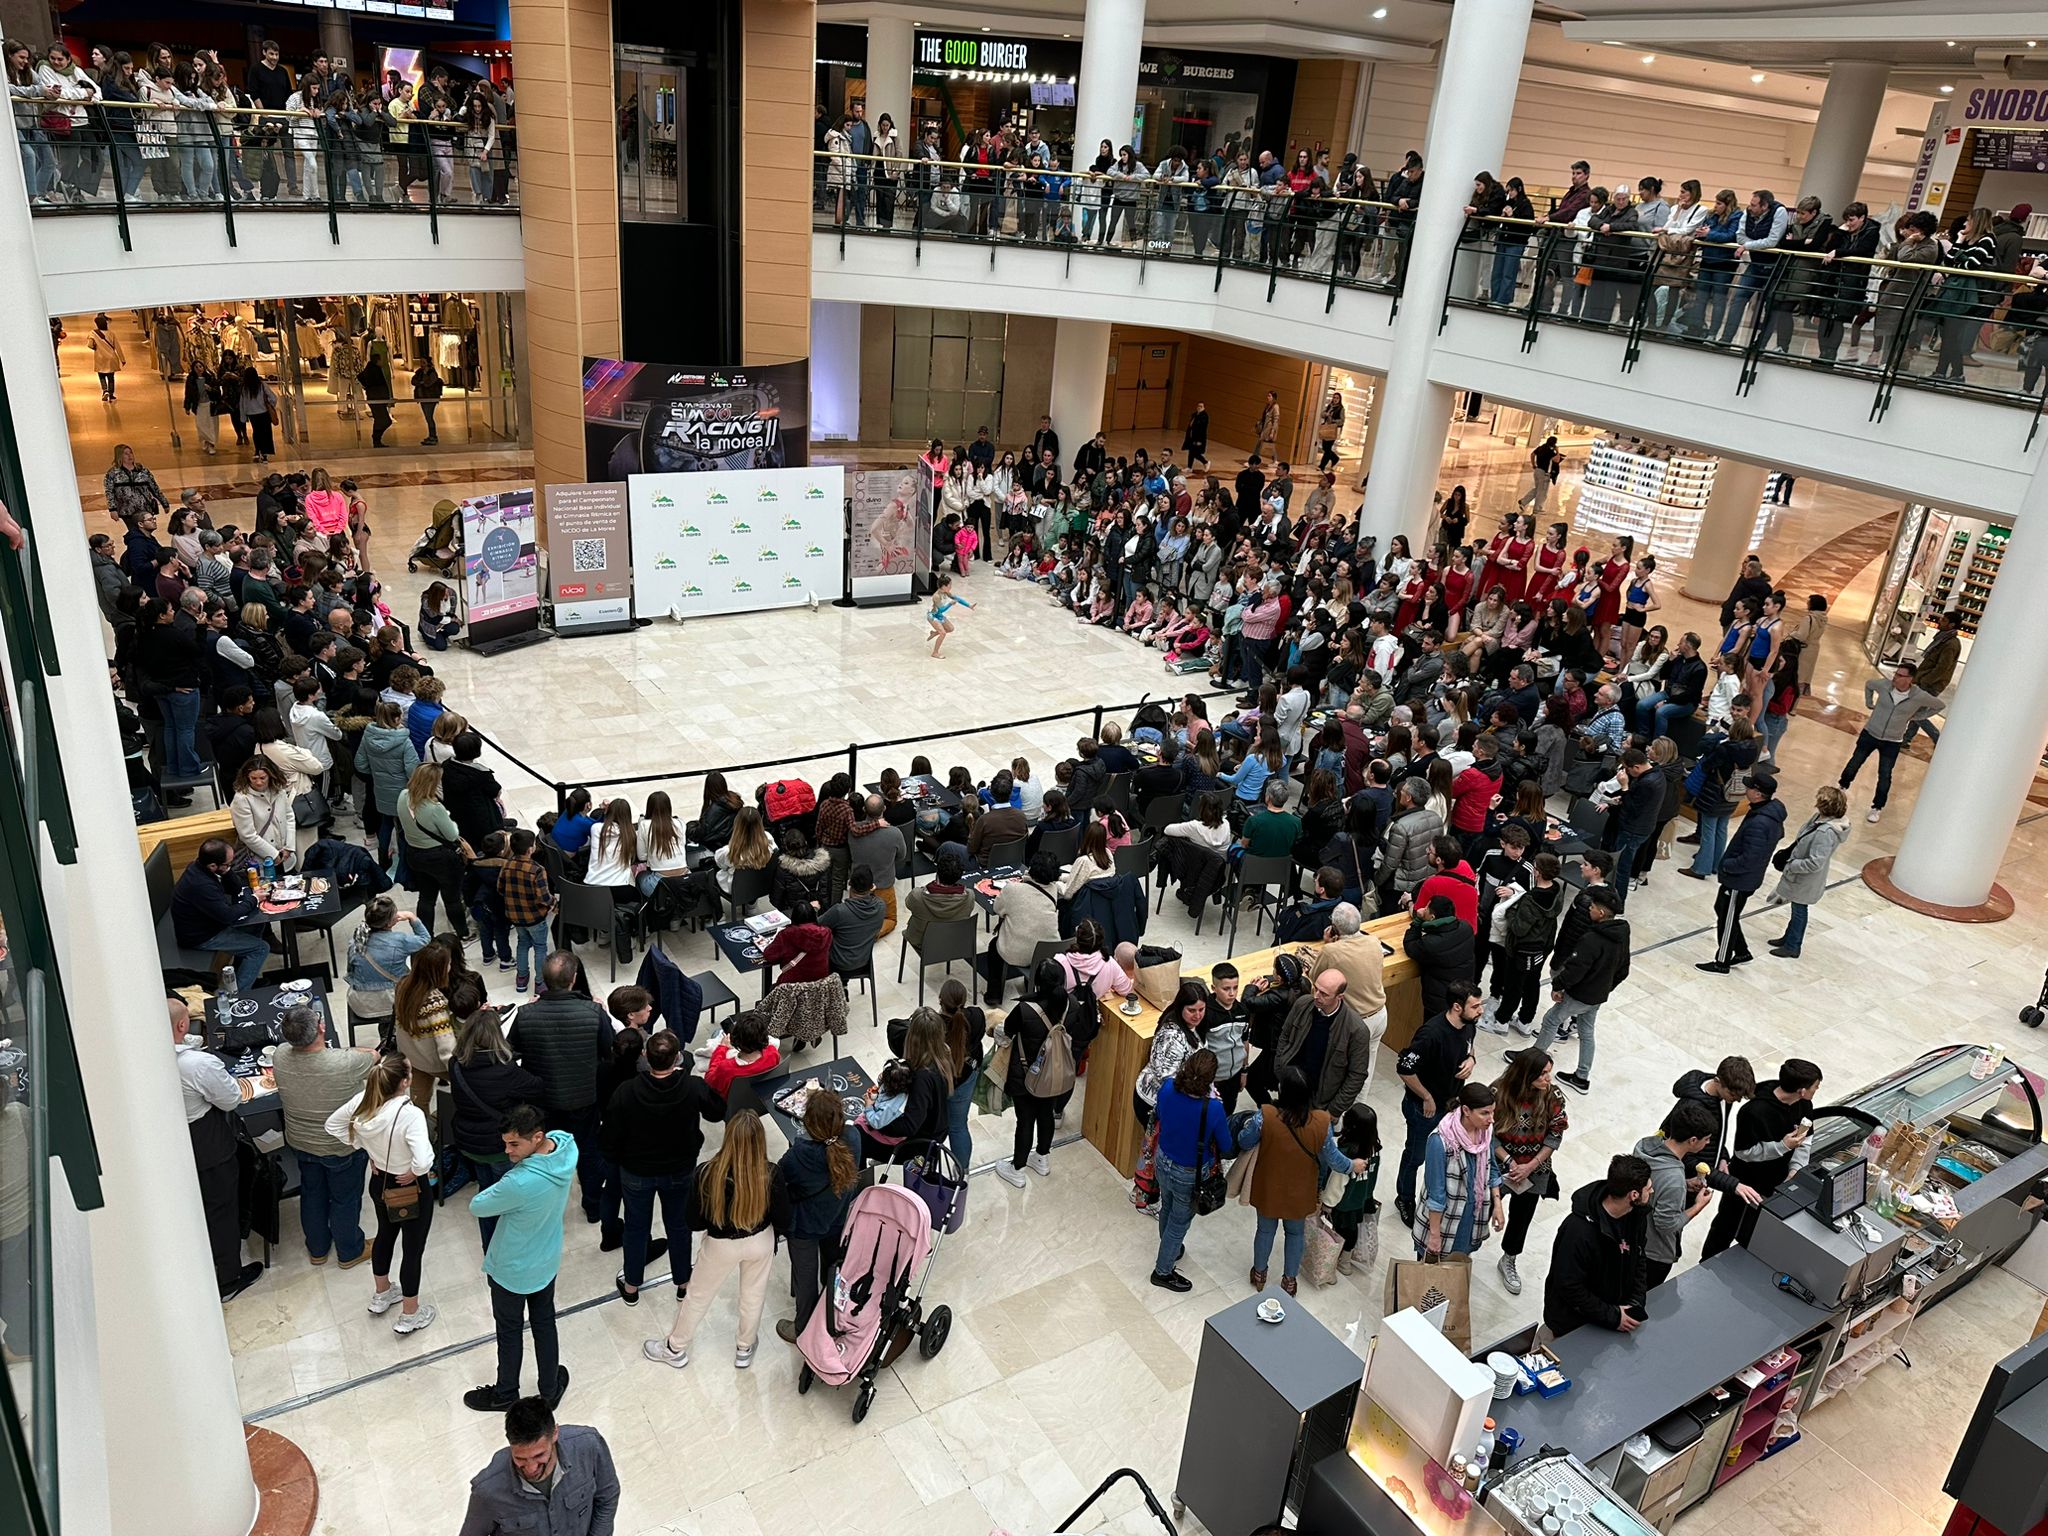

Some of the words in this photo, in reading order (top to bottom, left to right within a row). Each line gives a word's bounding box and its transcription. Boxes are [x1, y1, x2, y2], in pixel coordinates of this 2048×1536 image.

[920, 38, 942, 63] THE
[945, 39, 977, 65] GOOD
[980, 41, 1027, 69] BURGER
[1140, 62, 1158, 73] WE
[1182, 65, 1234, 79] BURGERS
[661, 420, 764, 443] RACING
[696, 433, 710, 449] la
[718, 436, 763, 449] morea
